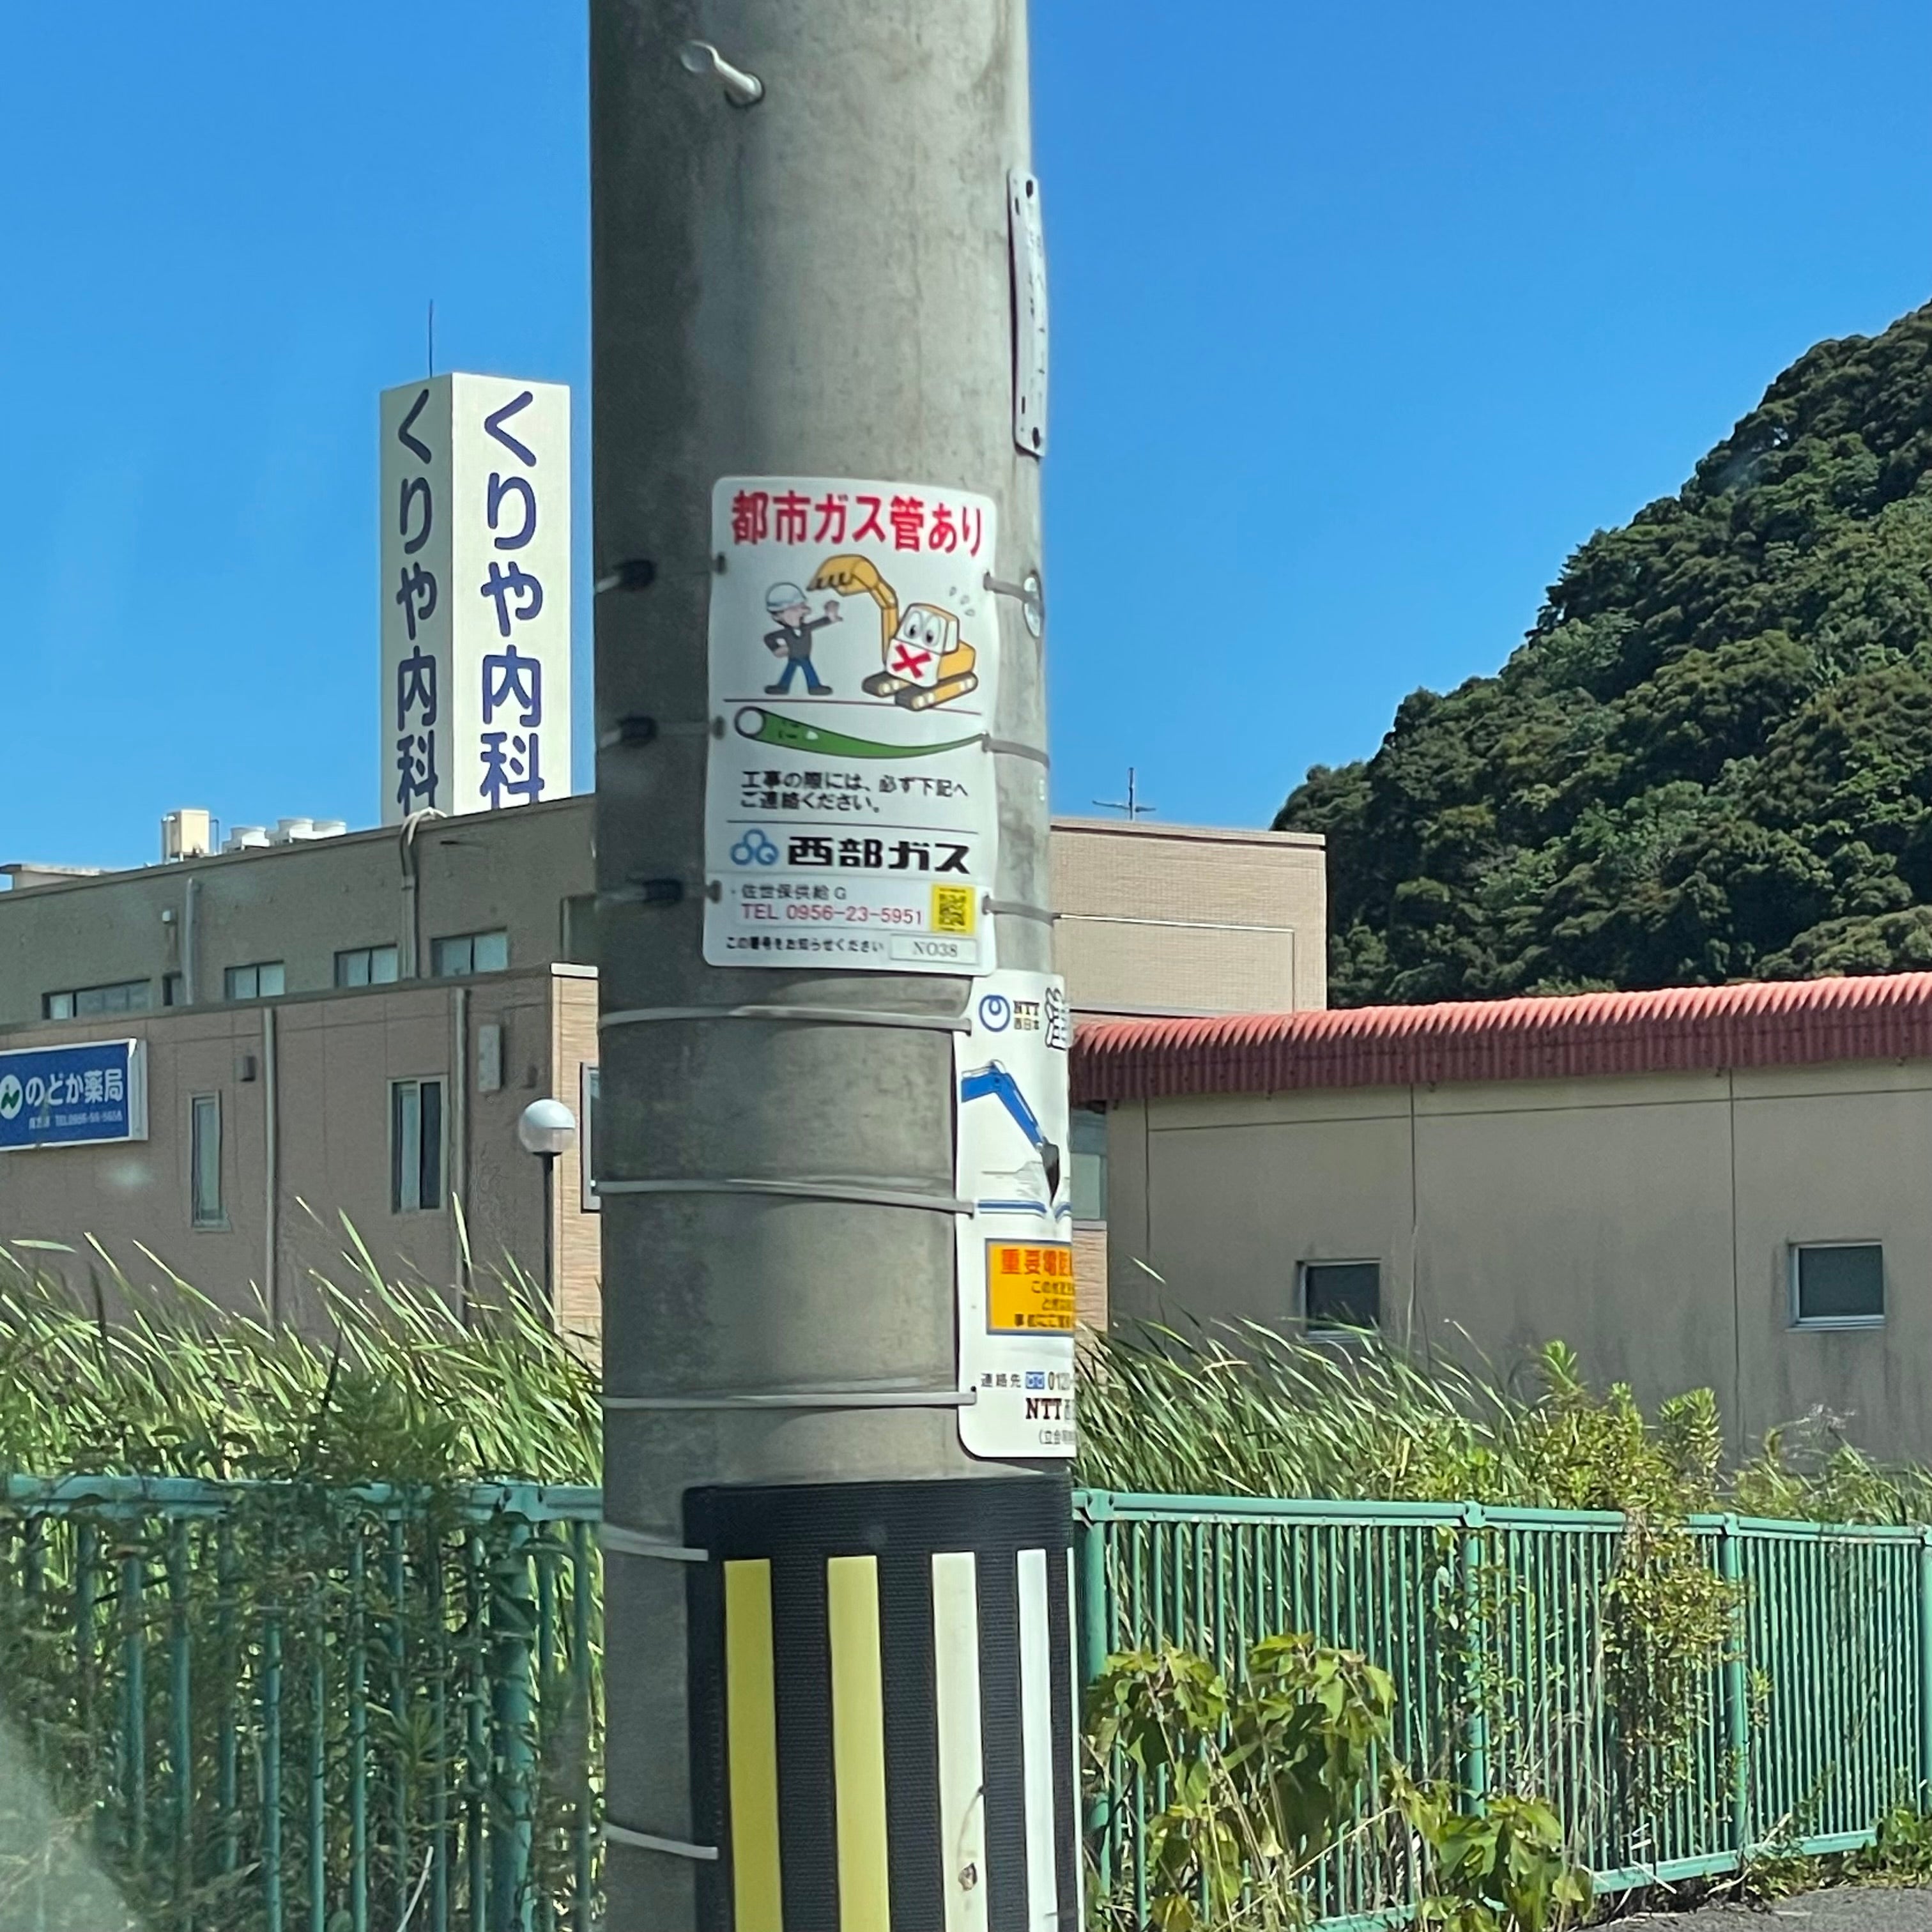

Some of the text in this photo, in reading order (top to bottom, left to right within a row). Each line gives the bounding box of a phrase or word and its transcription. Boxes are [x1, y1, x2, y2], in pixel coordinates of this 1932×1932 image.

[732, 490, 982, 556] 都市ガス管あり
[396, 388, 439, 816] くりや内科
[480, 390, 545, 809] くりや内科
[788, 836, 970, 874] 西部ガス
[741, 903, 923, 924] TEL 0956-23-5951
[25, 1068, 123, 1107] のどか薬局
